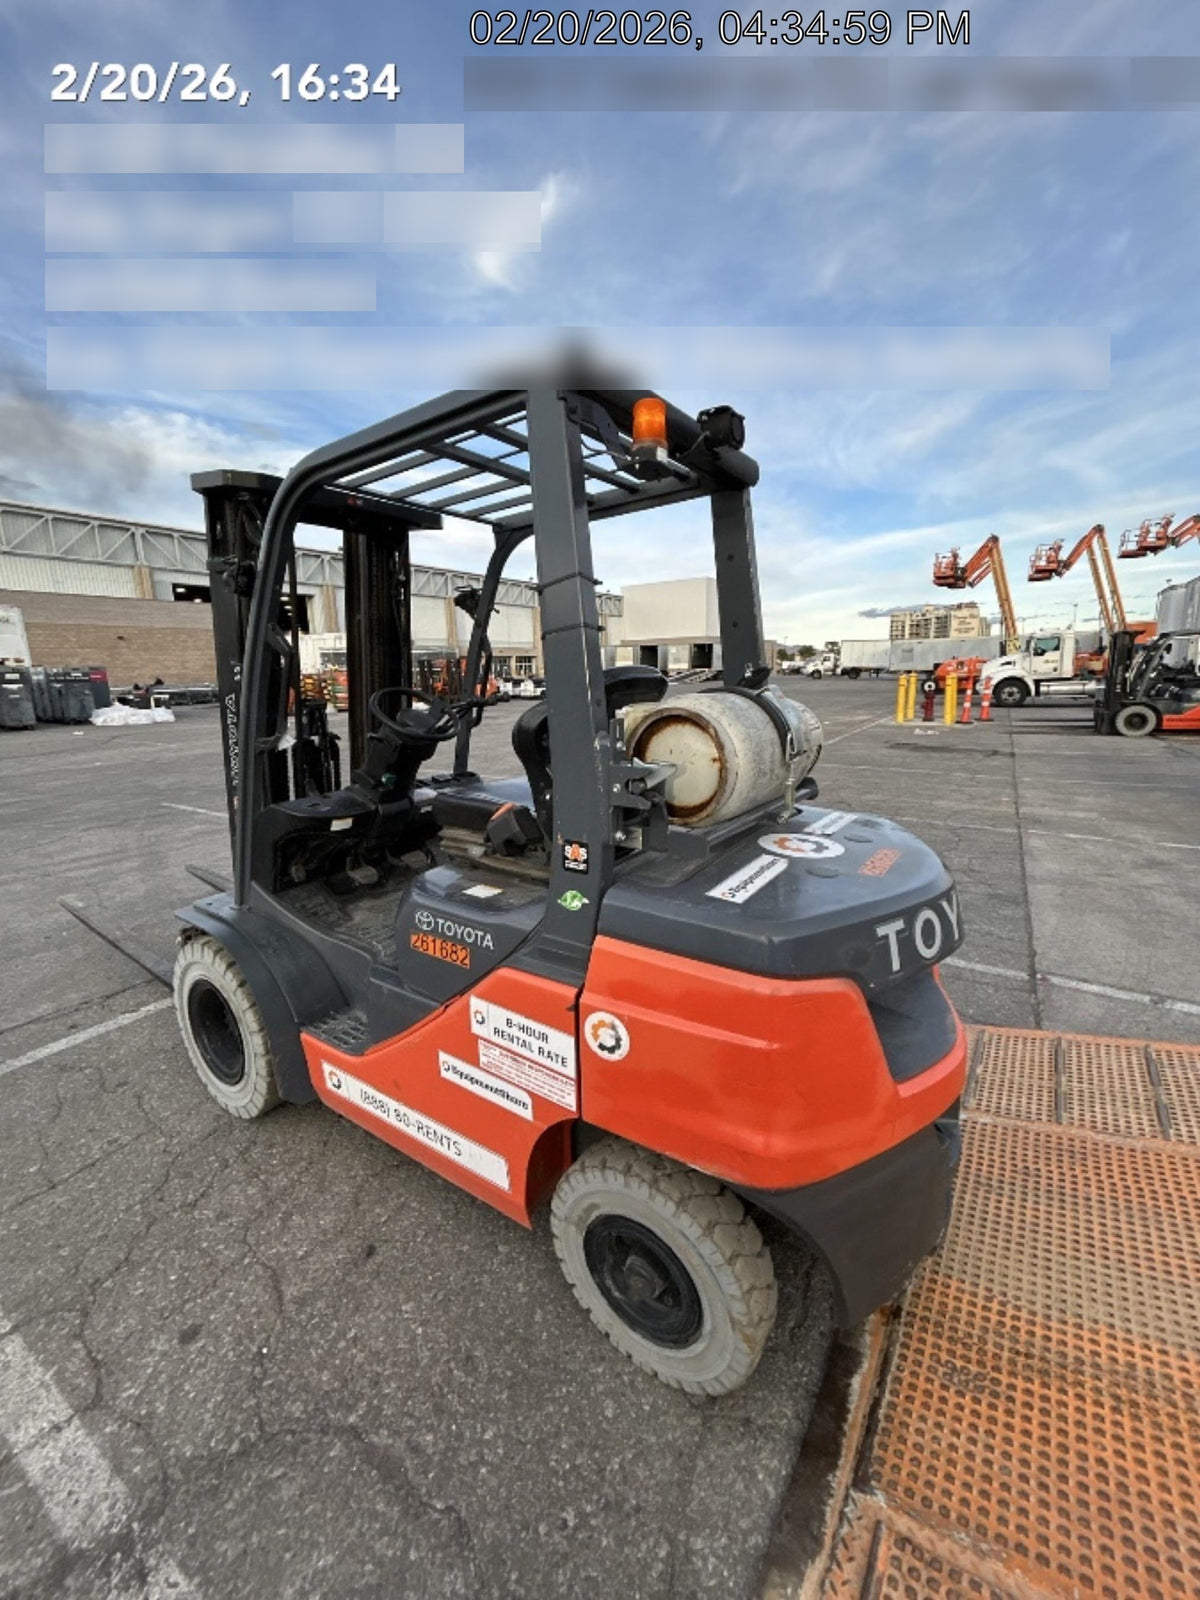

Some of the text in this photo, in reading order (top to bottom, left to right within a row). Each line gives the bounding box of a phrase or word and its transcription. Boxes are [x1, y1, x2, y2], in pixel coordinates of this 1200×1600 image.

[412, 934, 469, 967] 261682
[436, 918, 494, 950] TOYOTA
[493, 1027, 568, 1068] RENTAL RATE
[394, 1108, 463, 1157] 80-RENTS
